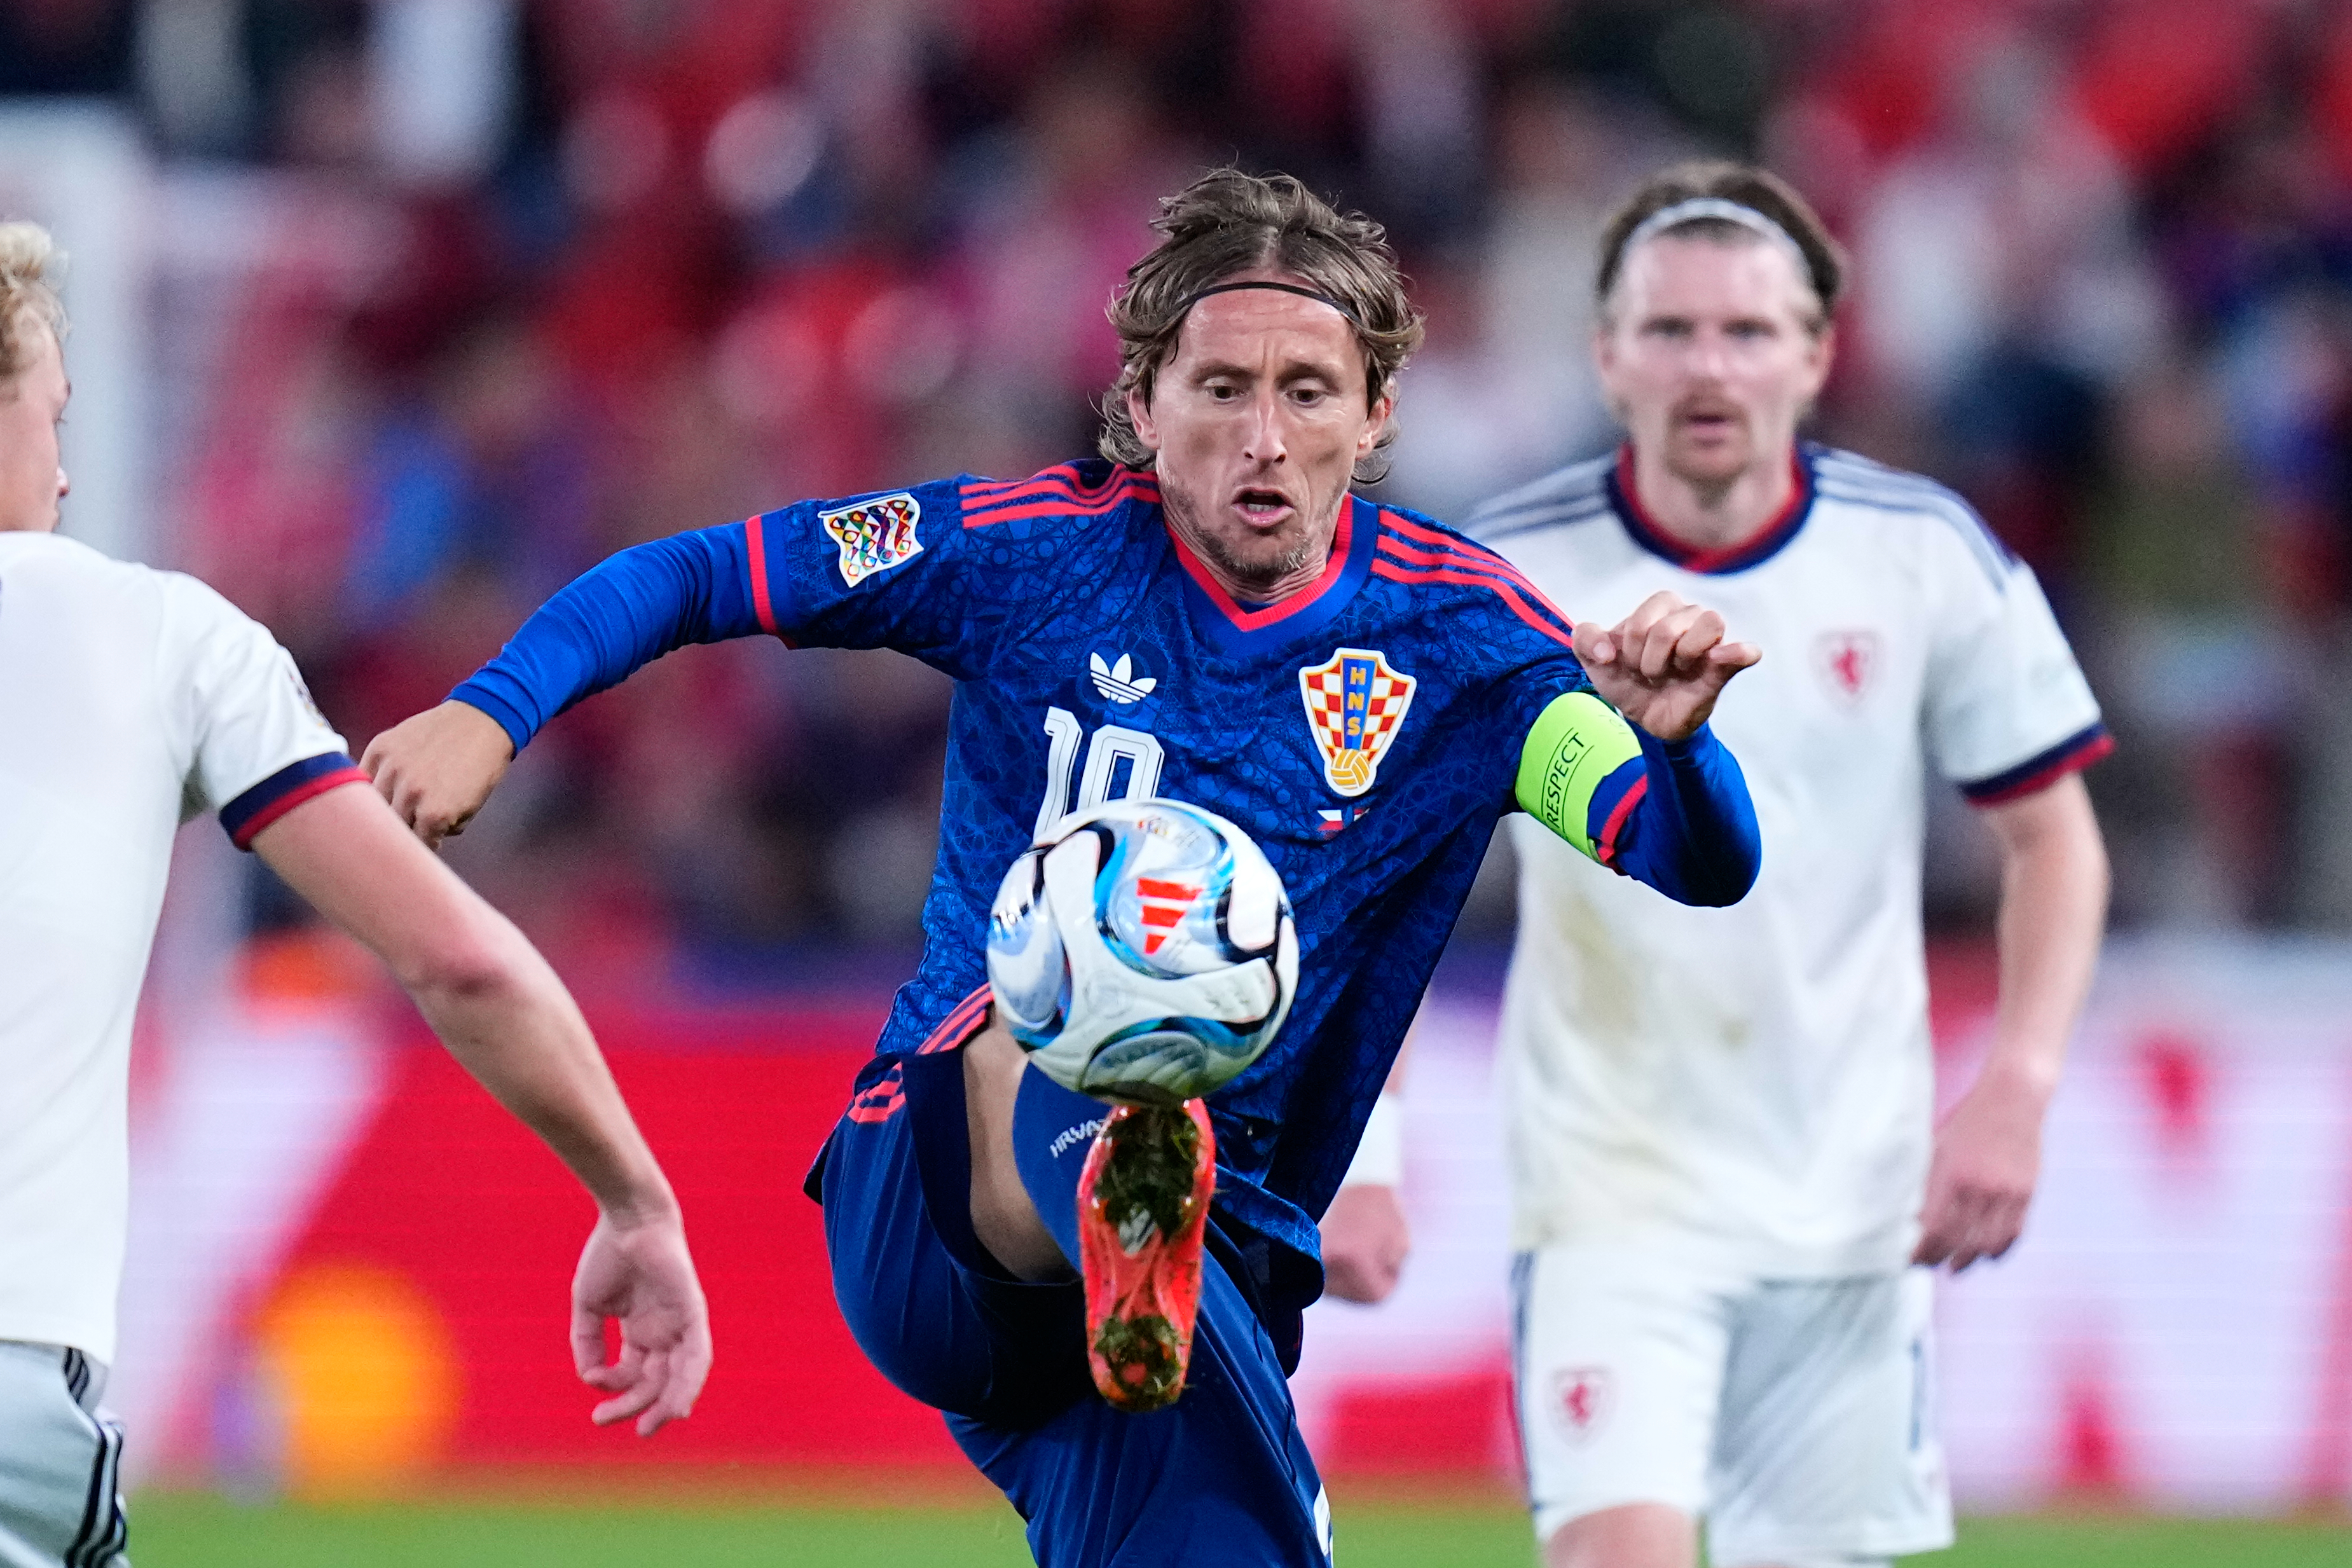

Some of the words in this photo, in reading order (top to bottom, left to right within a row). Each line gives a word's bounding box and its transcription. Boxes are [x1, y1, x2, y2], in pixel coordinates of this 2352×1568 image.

[1347, 666, 1366, 736] HNS
[1033, 706, 1165, 844] 10
[1546, 732, 1585, 829] RESPECT
[1050, 1119, 1106, 1159] HRVA
